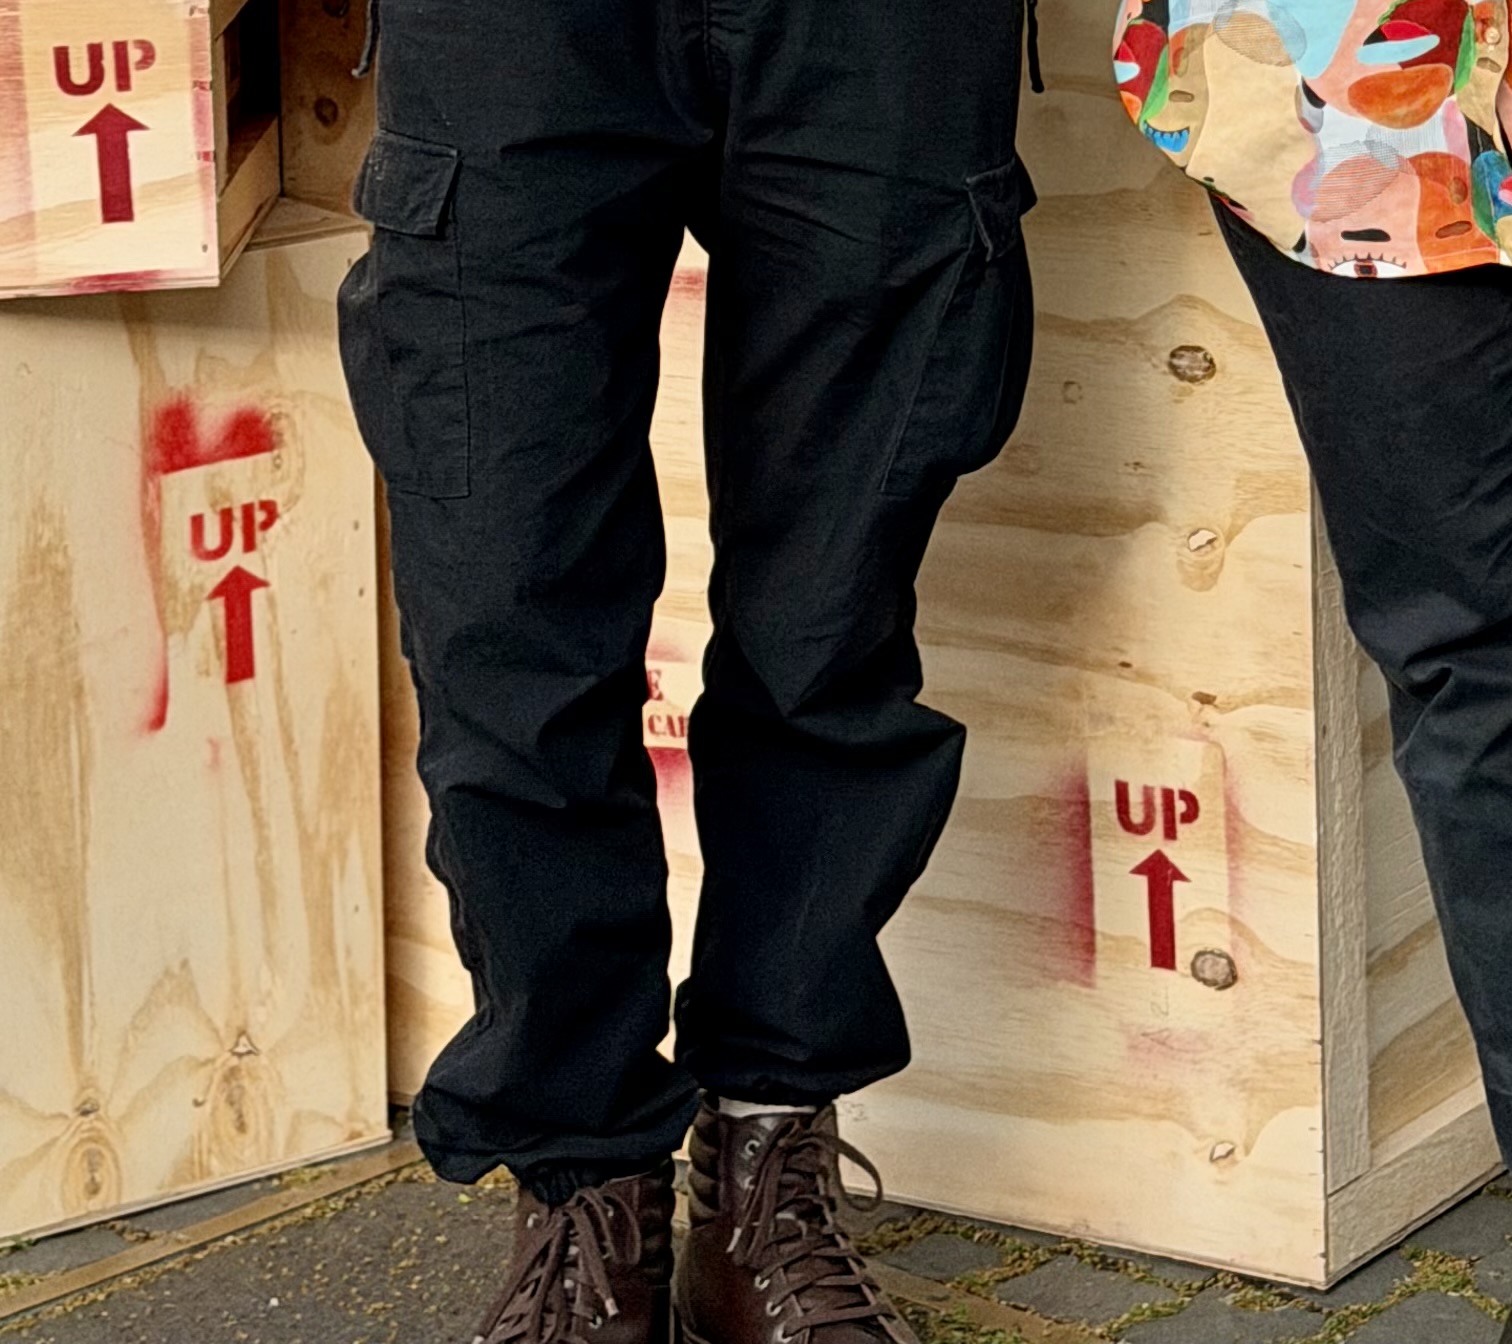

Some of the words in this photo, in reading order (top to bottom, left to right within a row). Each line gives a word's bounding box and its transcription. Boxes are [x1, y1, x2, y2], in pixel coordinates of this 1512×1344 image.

[53, 40, 156, 97] UP
[190, 499, 279, 562] UP
[1115, 781, 1200, 842] UP
